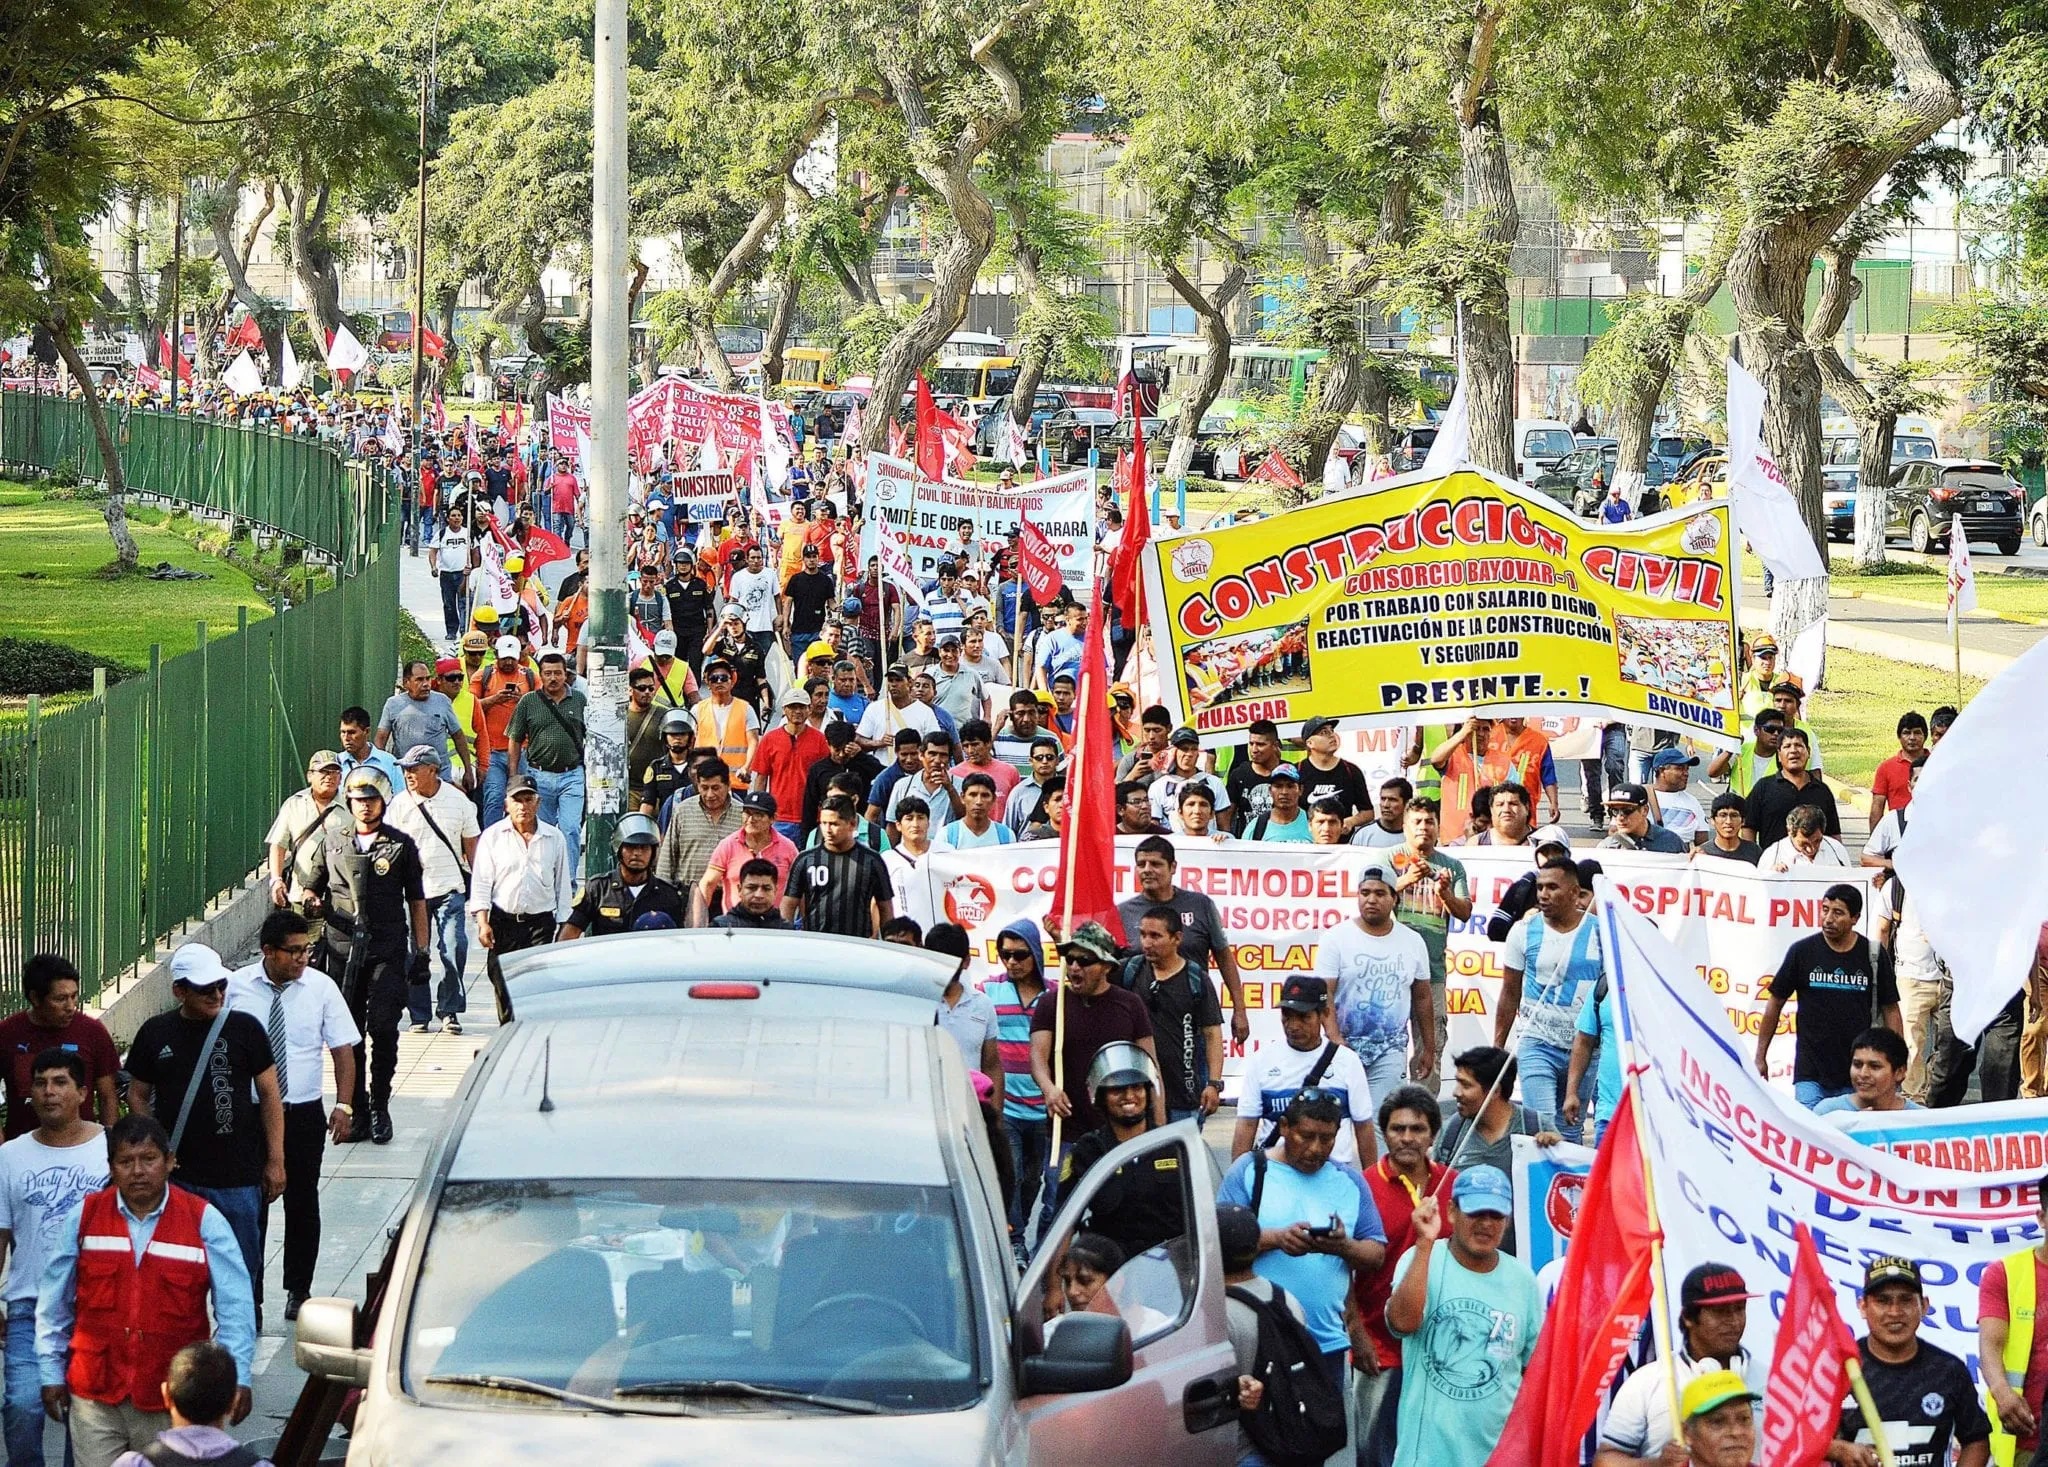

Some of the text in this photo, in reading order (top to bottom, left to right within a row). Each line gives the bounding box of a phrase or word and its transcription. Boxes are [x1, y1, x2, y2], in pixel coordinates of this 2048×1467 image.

[674, 474, 732, 498] MONSTRITO
[917, 486, 939, 503] CIVIL
[941, 490, 952, 505] DE
[954, 490, 976, 507] LIMA
[986, 495, 1043, 511] BALNEARIOS
[688, 503, 722, 520] CHIFA
[921, 512, 937, 529] DE
[1179, 497, 1724, 638] CONSTRUCCIÓN CIVIL
[1344, 559, 1465, 597] CONSORCIO
[1326, 590, 1602, 623] POR TRABAJO CON SALARIO DIGNO,
[1316, 612, 1612, 650] REACTIVACIÓN DE LA CONSTRUCCIÓN
[1421, 641, 1520, 666] Y SEGURIDAD
[1197, 700, 1288, 730] HUASCAR
[1648, 692, 1724, 730] BAYOVAR
[1314, 784, 1336, 795] NIKE
[807, 864, 829, 887] 10
[1354, 951, 1405, 984] Tough
[1808, 972, 1869, 986] QUIKSILVER
[210, 1037, 234, 1124] adidas
[1893, 1132, 2048, 1174] TRABAJAD
[22, 1166, 67, 1201] Dusty
[1871, 1255, 1912, 1271] GUCCI
[1489, 1310, 1516, 1341] 73
